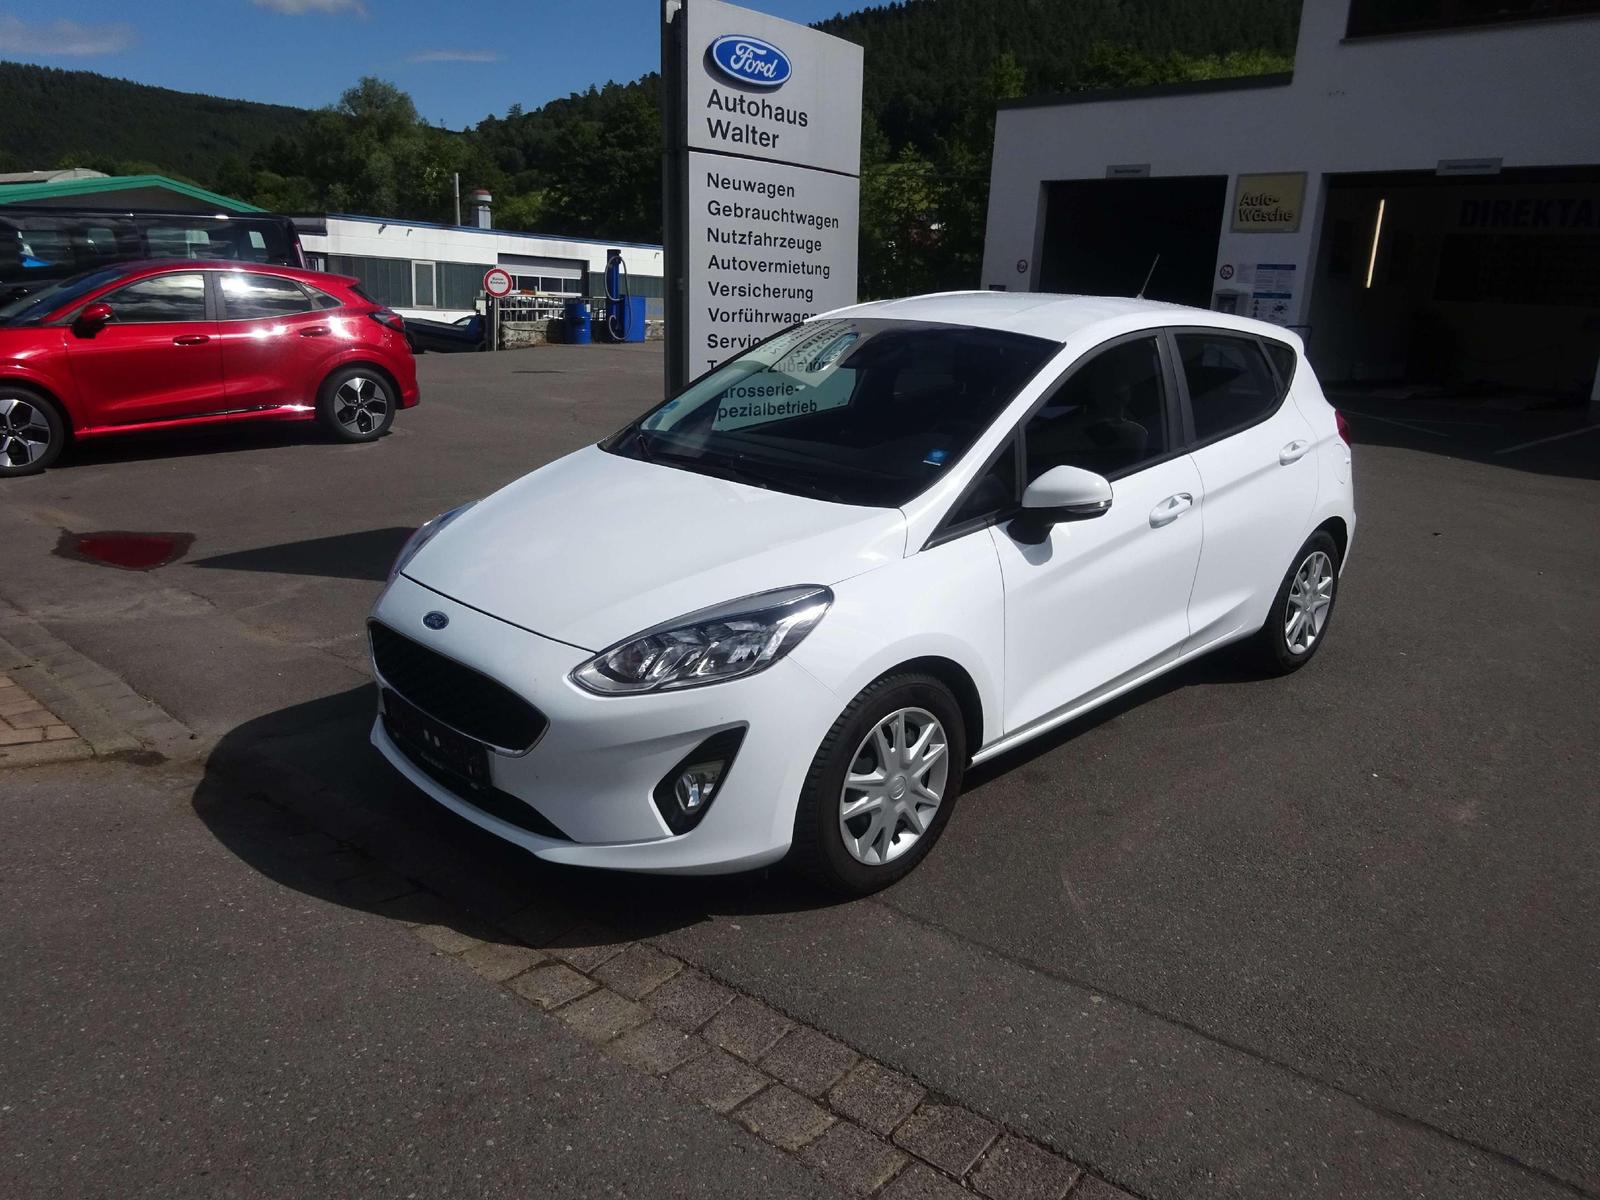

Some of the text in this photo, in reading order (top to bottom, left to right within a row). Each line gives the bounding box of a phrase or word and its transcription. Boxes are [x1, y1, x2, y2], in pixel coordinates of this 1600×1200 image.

[730, 42, 778, 79] Ford
[706, 88, 809, 127] Autohaus
[706, 117, 780, 149] Walter
[706, 172, 796, 199] Neuwagen
[1239, 191, 1281, 207] Auto-
[706, 200, 840, 230] Gebrauchtwagen
[1458, 198, 1600, 228] DIREKTA
[706, 227, 822, 254] Nutzfahrzeuge
[707, 254, 831, 280] Autovermietung
[707, 281, 814, 303] Versicherung
[717, 400, 818, 422] pezialbetrieb
